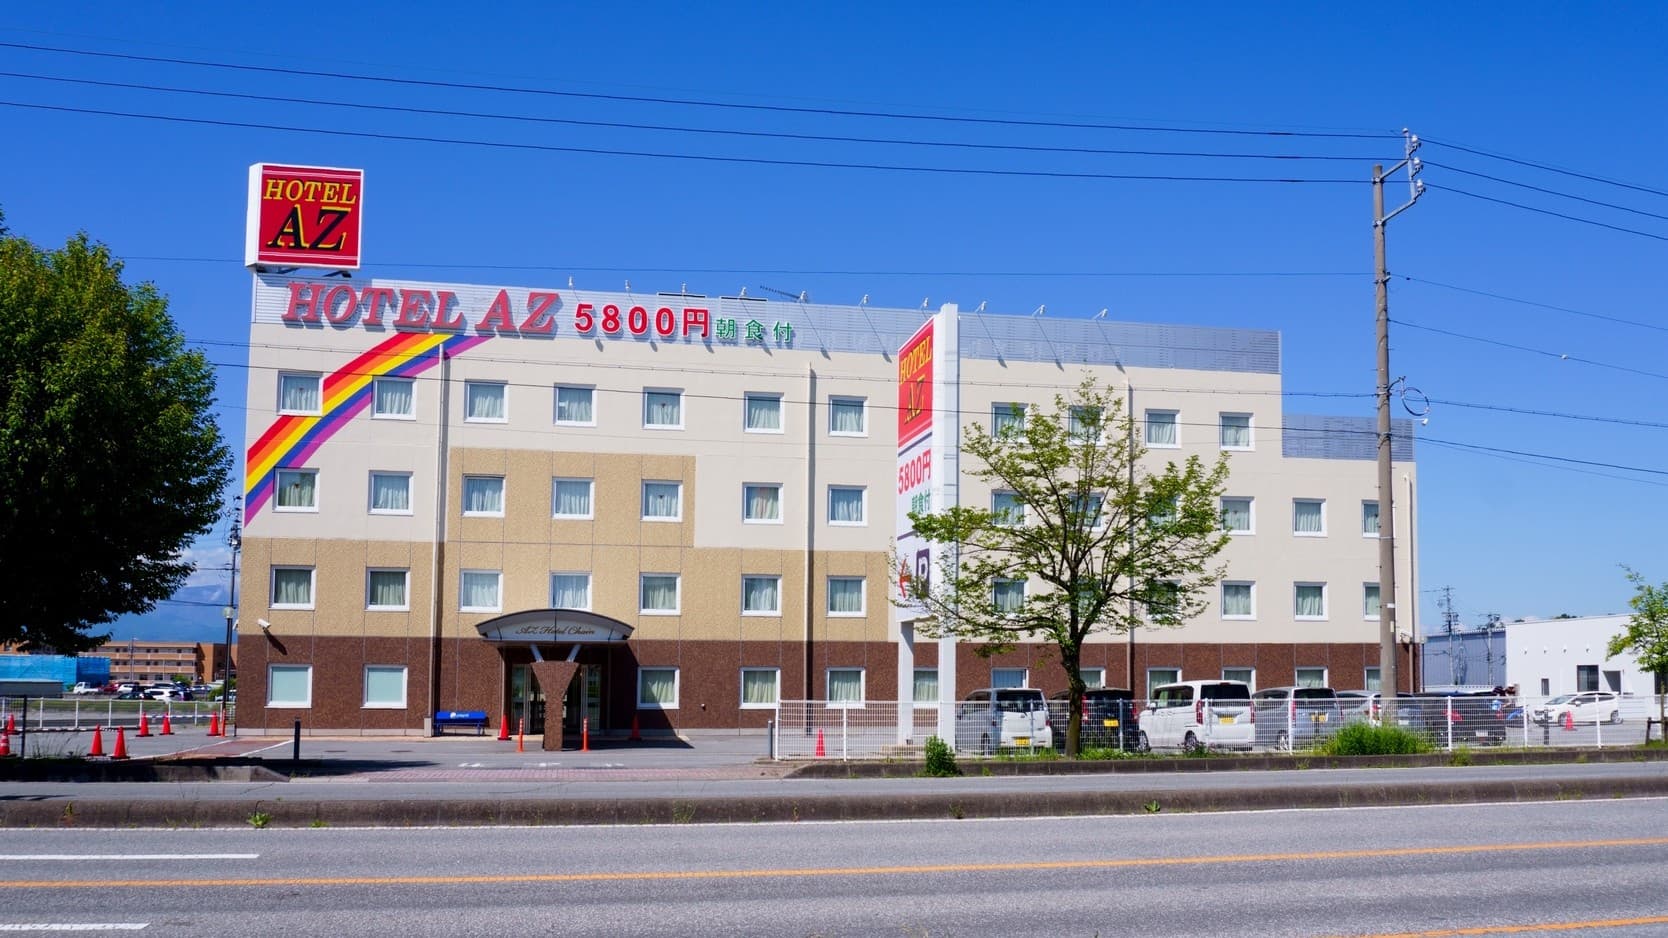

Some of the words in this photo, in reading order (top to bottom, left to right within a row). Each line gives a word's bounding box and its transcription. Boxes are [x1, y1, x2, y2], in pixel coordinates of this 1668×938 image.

[263, 179, 357, 204] HOTEL
[266, 203, 352, 250] AZ
[281, 281, 464, 328] HOTEL
[475, 288, 561, 334] AZ
[574, 303, 710, 339] 5800円
[715, 317, 793, 342] 朝食付
[900, 335, 932, 385] HOTEL
[904, 374, 926, 426] AZ
[898, 448, 932, 495] 5800円
